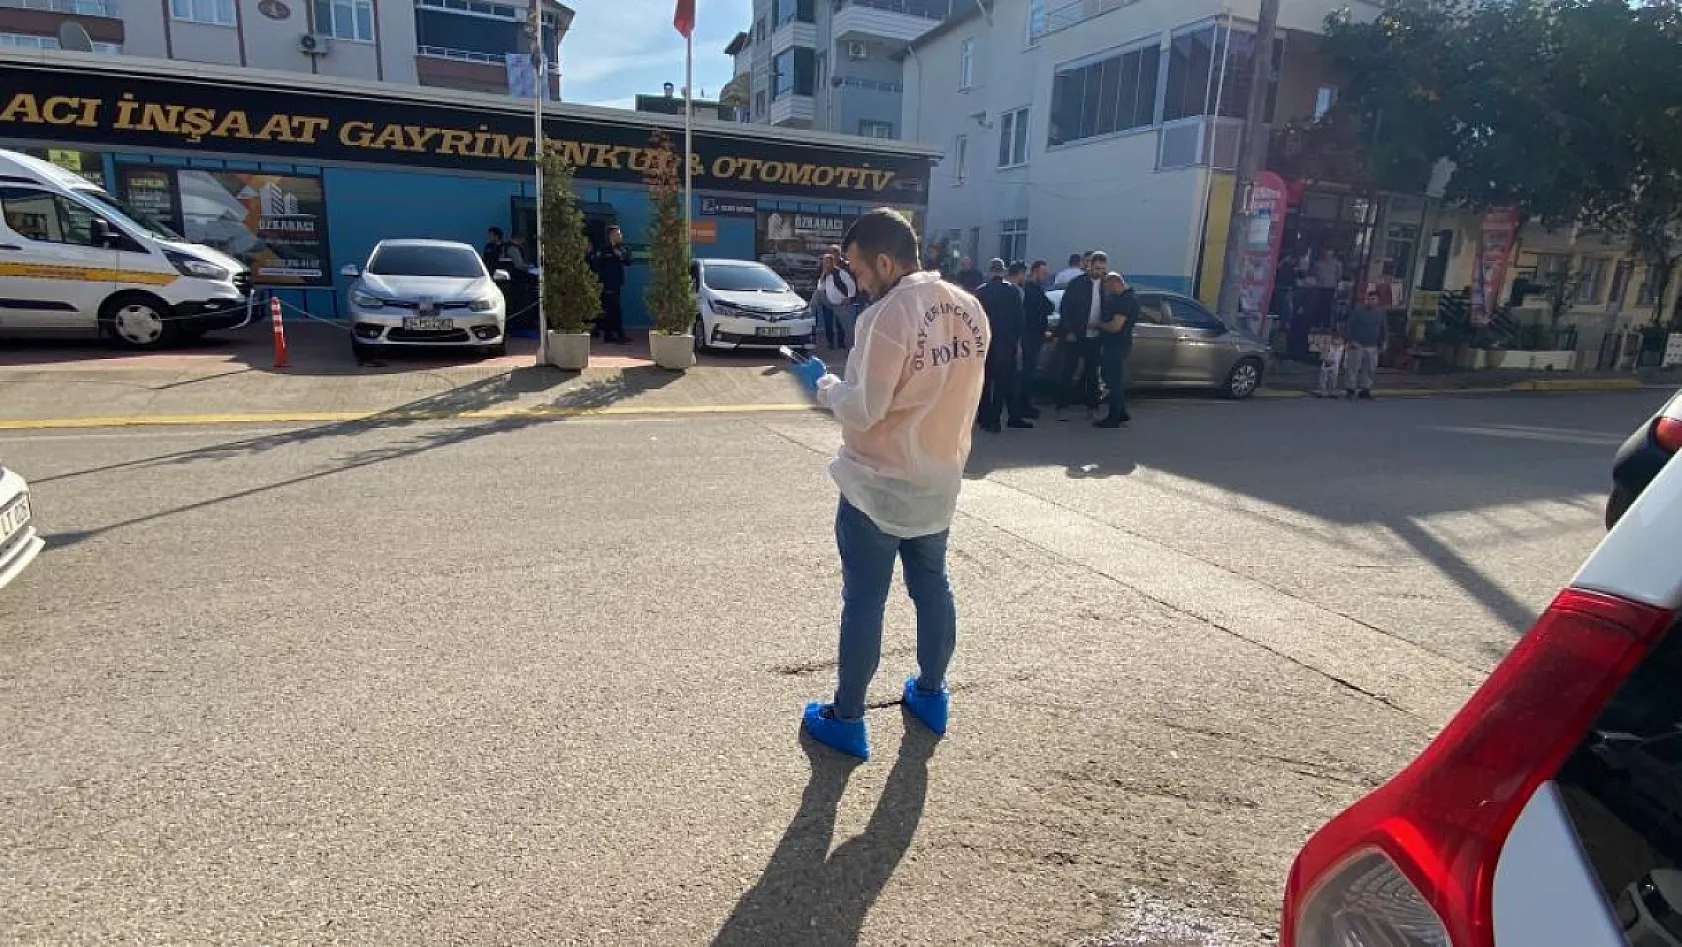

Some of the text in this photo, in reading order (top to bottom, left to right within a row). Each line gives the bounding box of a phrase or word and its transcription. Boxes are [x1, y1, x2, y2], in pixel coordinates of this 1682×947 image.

[0, 93, 101, 127] ACI
[113, 92, 330, 143] İNŞAAT
[338, 121, 677, 175] GAYRİMNKU
[711, 155, 896, 192] OTOMOTİV
